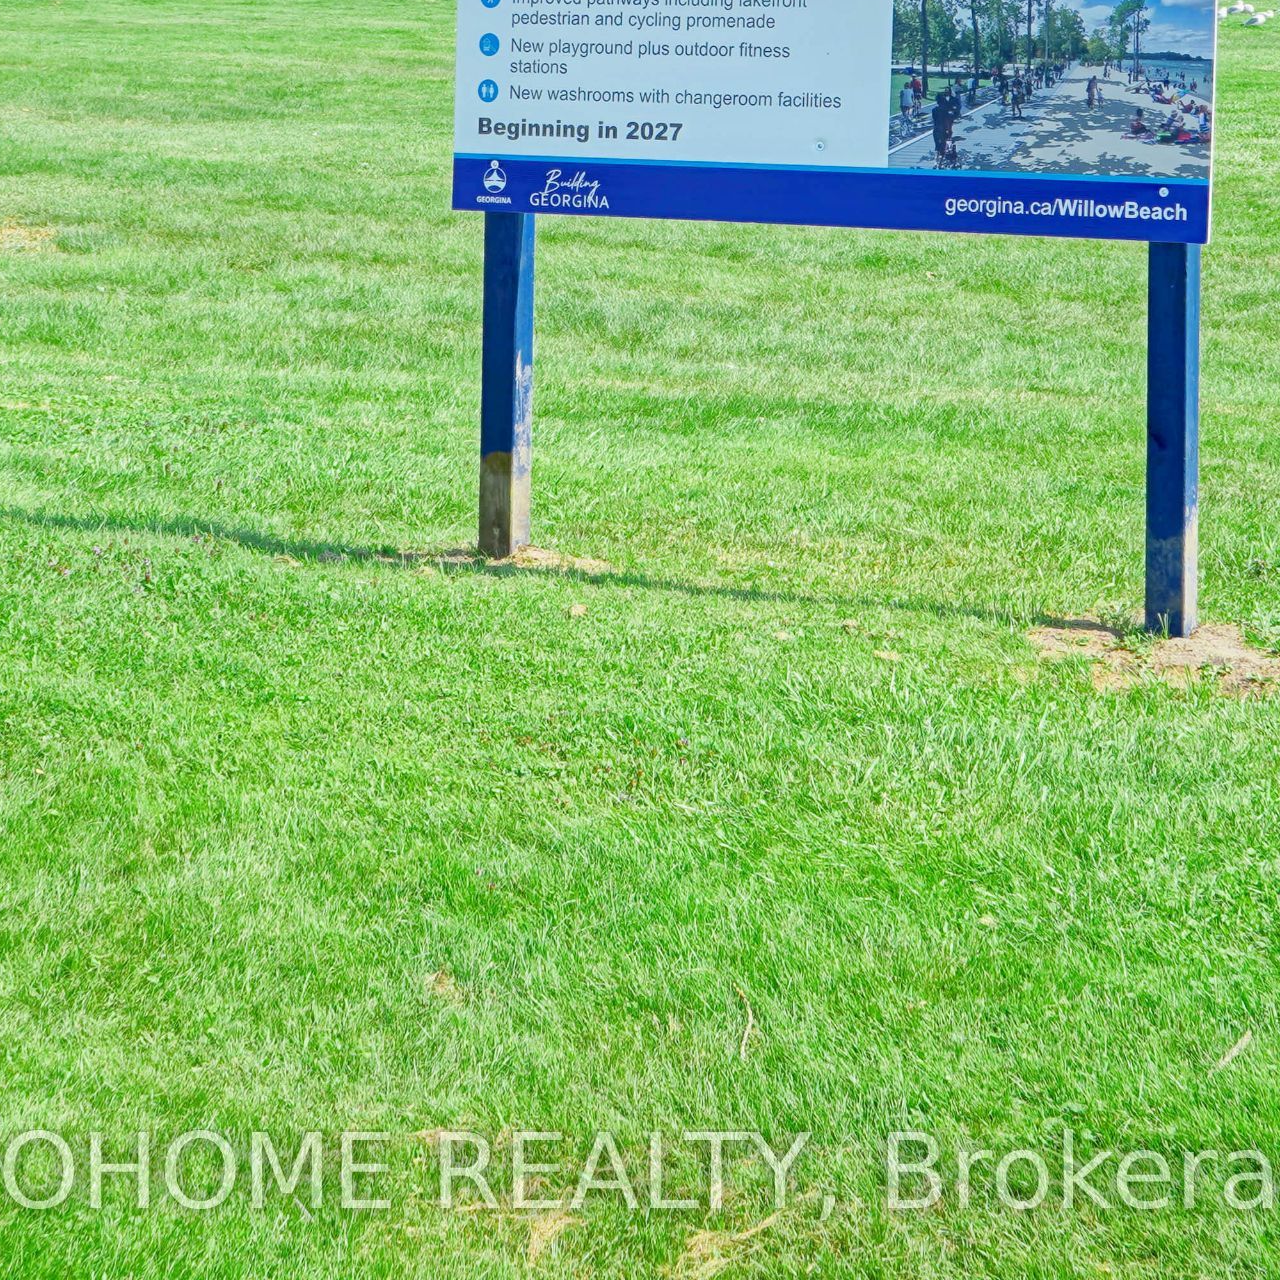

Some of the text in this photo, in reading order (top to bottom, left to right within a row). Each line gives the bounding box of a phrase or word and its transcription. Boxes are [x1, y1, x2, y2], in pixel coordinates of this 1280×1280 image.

[511, 11, 776, 31] pedestrian and cycling promenade
[511, 38, 791, 58] New playground plus outdoor fitness
[510, 59, 568, 74] stations
[509, 85, 842, 108] New washrooms with changeroom facilities
[478, 117, 683, 143] Beginning in 2027
[539, 169, 601, 203] Building
[476, 195, 512, 204] GEORGINA
[529, 192, 610, 209] GEORGINA
[945, 196, 1188, 221] georgina.ca/WillowBeach
